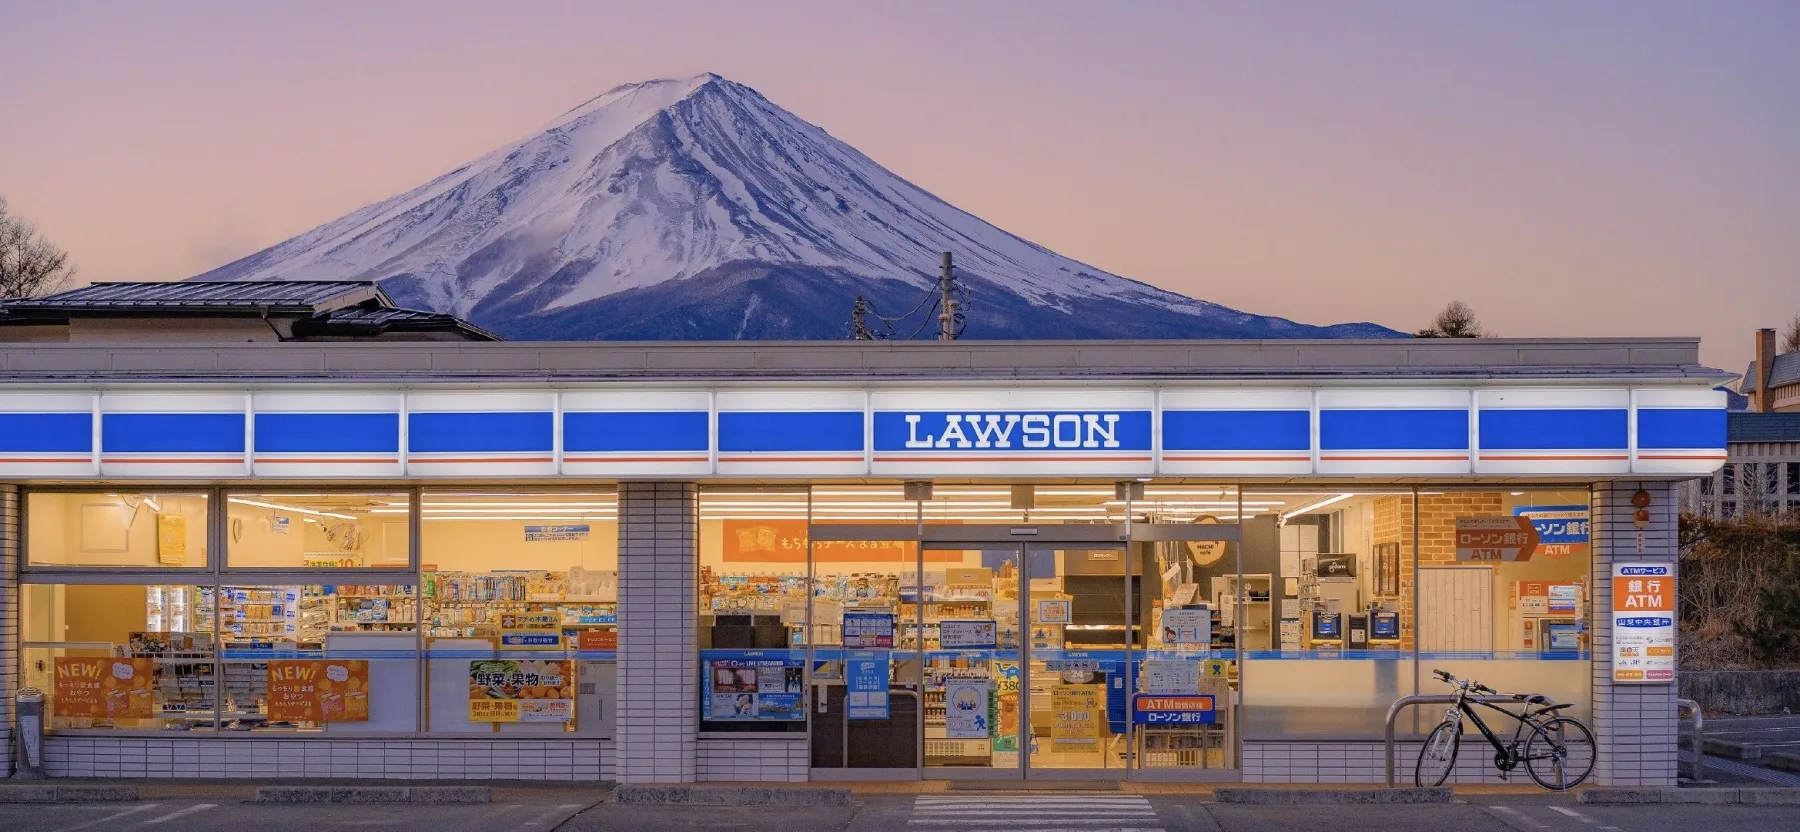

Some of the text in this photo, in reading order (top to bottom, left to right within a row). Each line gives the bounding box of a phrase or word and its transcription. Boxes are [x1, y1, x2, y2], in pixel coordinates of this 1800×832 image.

[905, 414, 1120, 448] LAWSON
[1460, 532, 1529, 545] ローソン銀行
[1470, 549, 1502, 560] ATM
[1544, 544, 1570, 555] ATM
[1622, 567, 1666, 575] ATMサービス
[1628, 580, 1661, 593] 銀行
[1625, 594, 1663, 608] ATM
[1617, 618, 1670, 626] 山梨中央銀行
[57, 662, 102, 680] NEW!
[271, 665, 317, 683] NEW!
[477, 673, 539, 686] 野菜・果物
[1148, 712, 1201, 722] ローソン銀行
